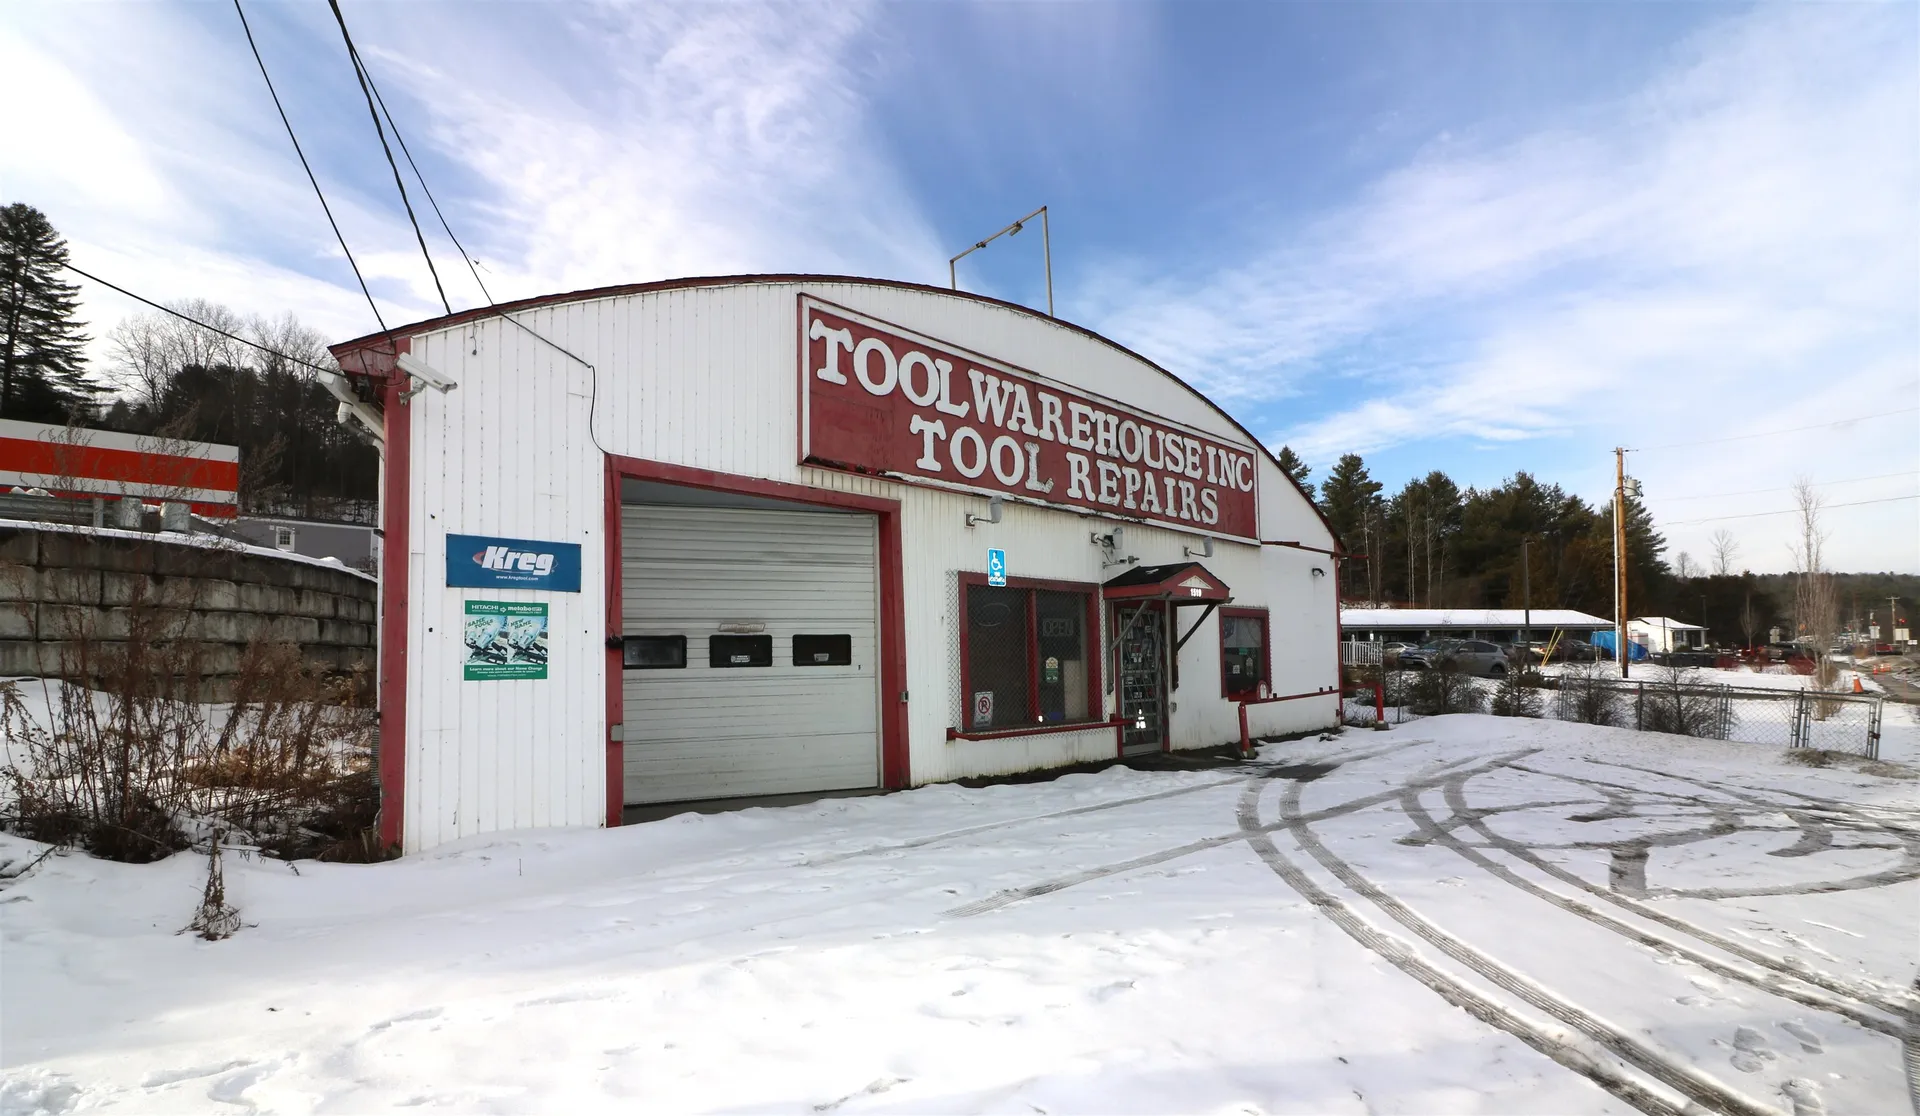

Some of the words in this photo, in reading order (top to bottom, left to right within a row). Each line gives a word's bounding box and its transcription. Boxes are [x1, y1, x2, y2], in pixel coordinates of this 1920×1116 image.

[809, 317, 970, 418] TOOL
[967, 369, 1203, 479] WAREHOUSE
[1204, 444, 1254, 493] INC
[909, 413, 1054, 494] TOOL
[1066, 452, 1219, 526] REPAIRS
[482, 546, 555, 576] Kreg
[467, 617, 486, 627] SAME
[475, 619, 494, 629] TOOLS
[510, 618, 524, 627] NEW
[514, 620, 532, 629] NAME
[1043, 619, 1074, 636] OPEN
